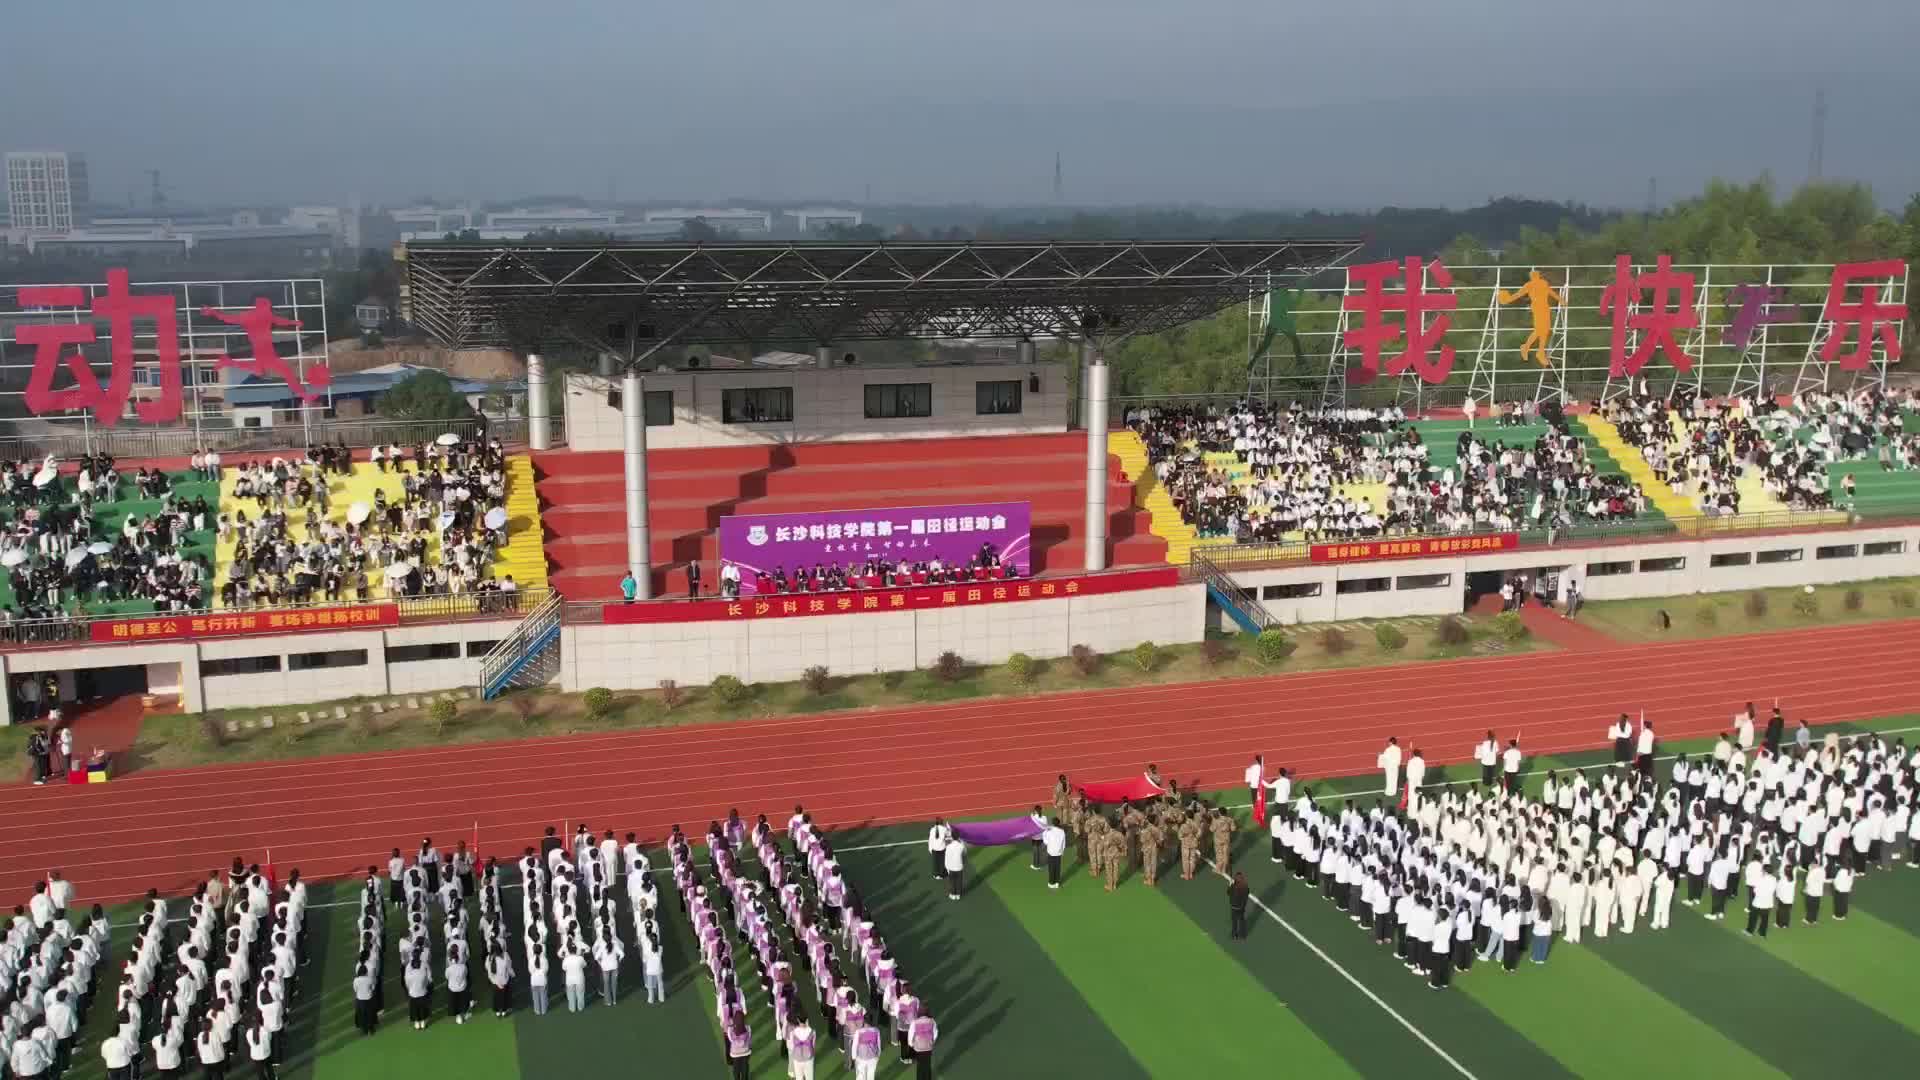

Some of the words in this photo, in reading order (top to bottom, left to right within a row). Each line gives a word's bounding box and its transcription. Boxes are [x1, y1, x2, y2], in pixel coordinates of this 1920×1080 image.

[1343, 256, 1457, 385] 我
[1601, 254, 1698, 377] 快
[1820, 259, 1908, 370] 乐
[15, 267, 184, 427] 动
[775, 514, 1007, 542] 长沙科技学院第一届田径运动会
[727, 580, 1080, 616] 长沙科技学院第一届田径运动会
[112, 620, 177, 637] 明德至公
